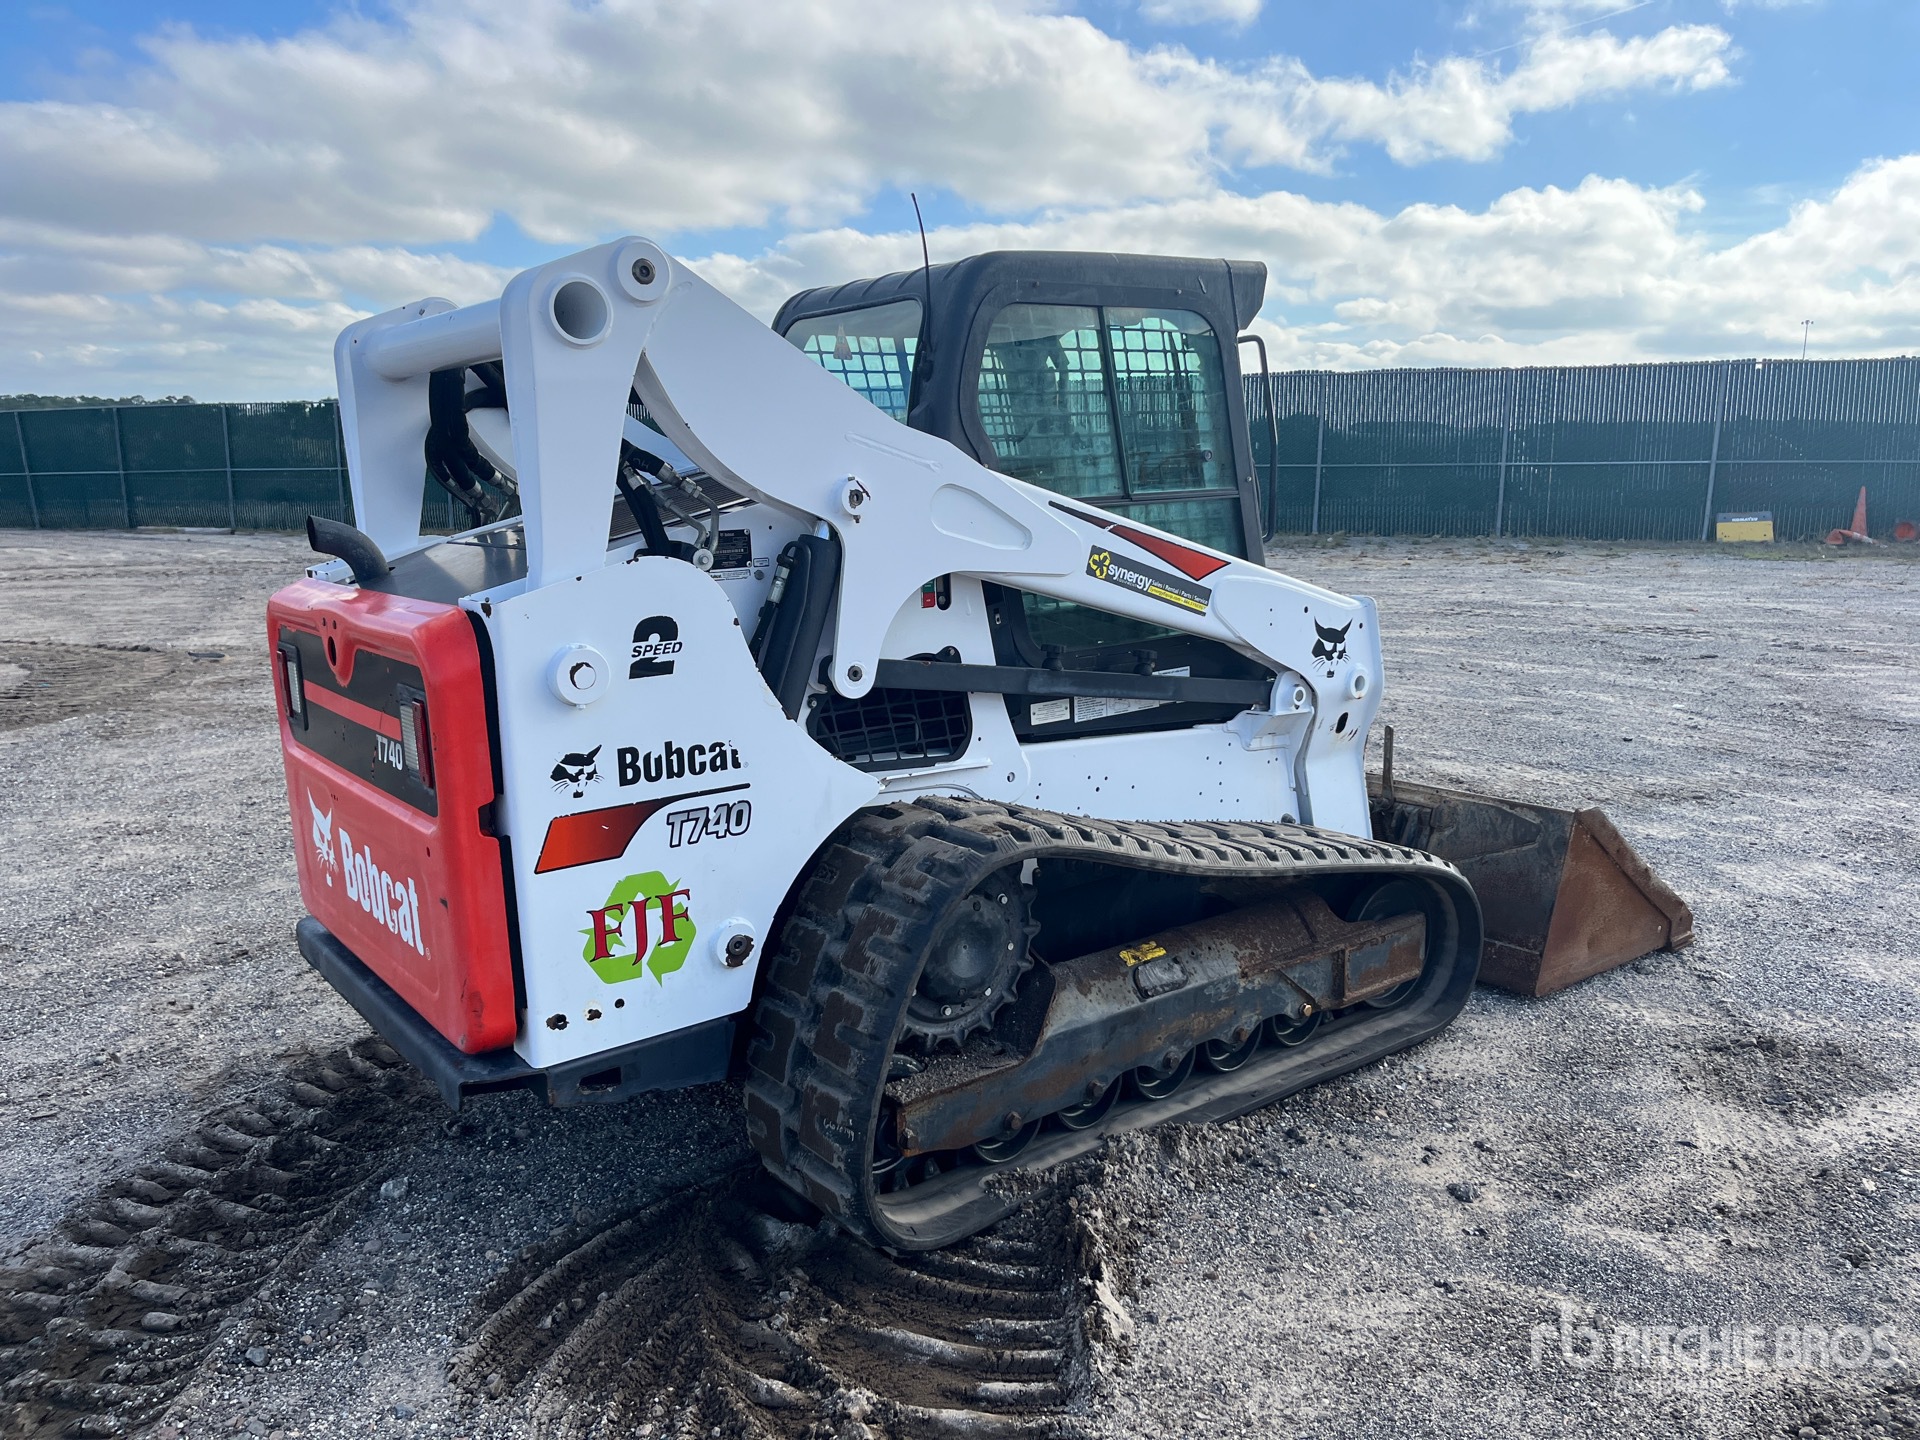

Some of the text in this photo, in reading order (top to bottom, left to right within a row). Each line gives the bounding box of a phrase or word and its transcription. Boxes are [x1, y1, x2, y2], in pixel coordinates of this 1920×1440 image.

[1107, 564, 1152, 591] synergy
[1152, 579, 1208, 605] Sales Rental Parts Service
[628, 615, 679, 680] 2
[631, 641, 683, 658] SPEED
[375, 734, 403, 771] T740
[616, 739, 742, 787] Bobcat
[667, 800, 751, 848] T740
[339, 827, 425, 957] Bobcat
[586, 888, 691, 966] FJF
